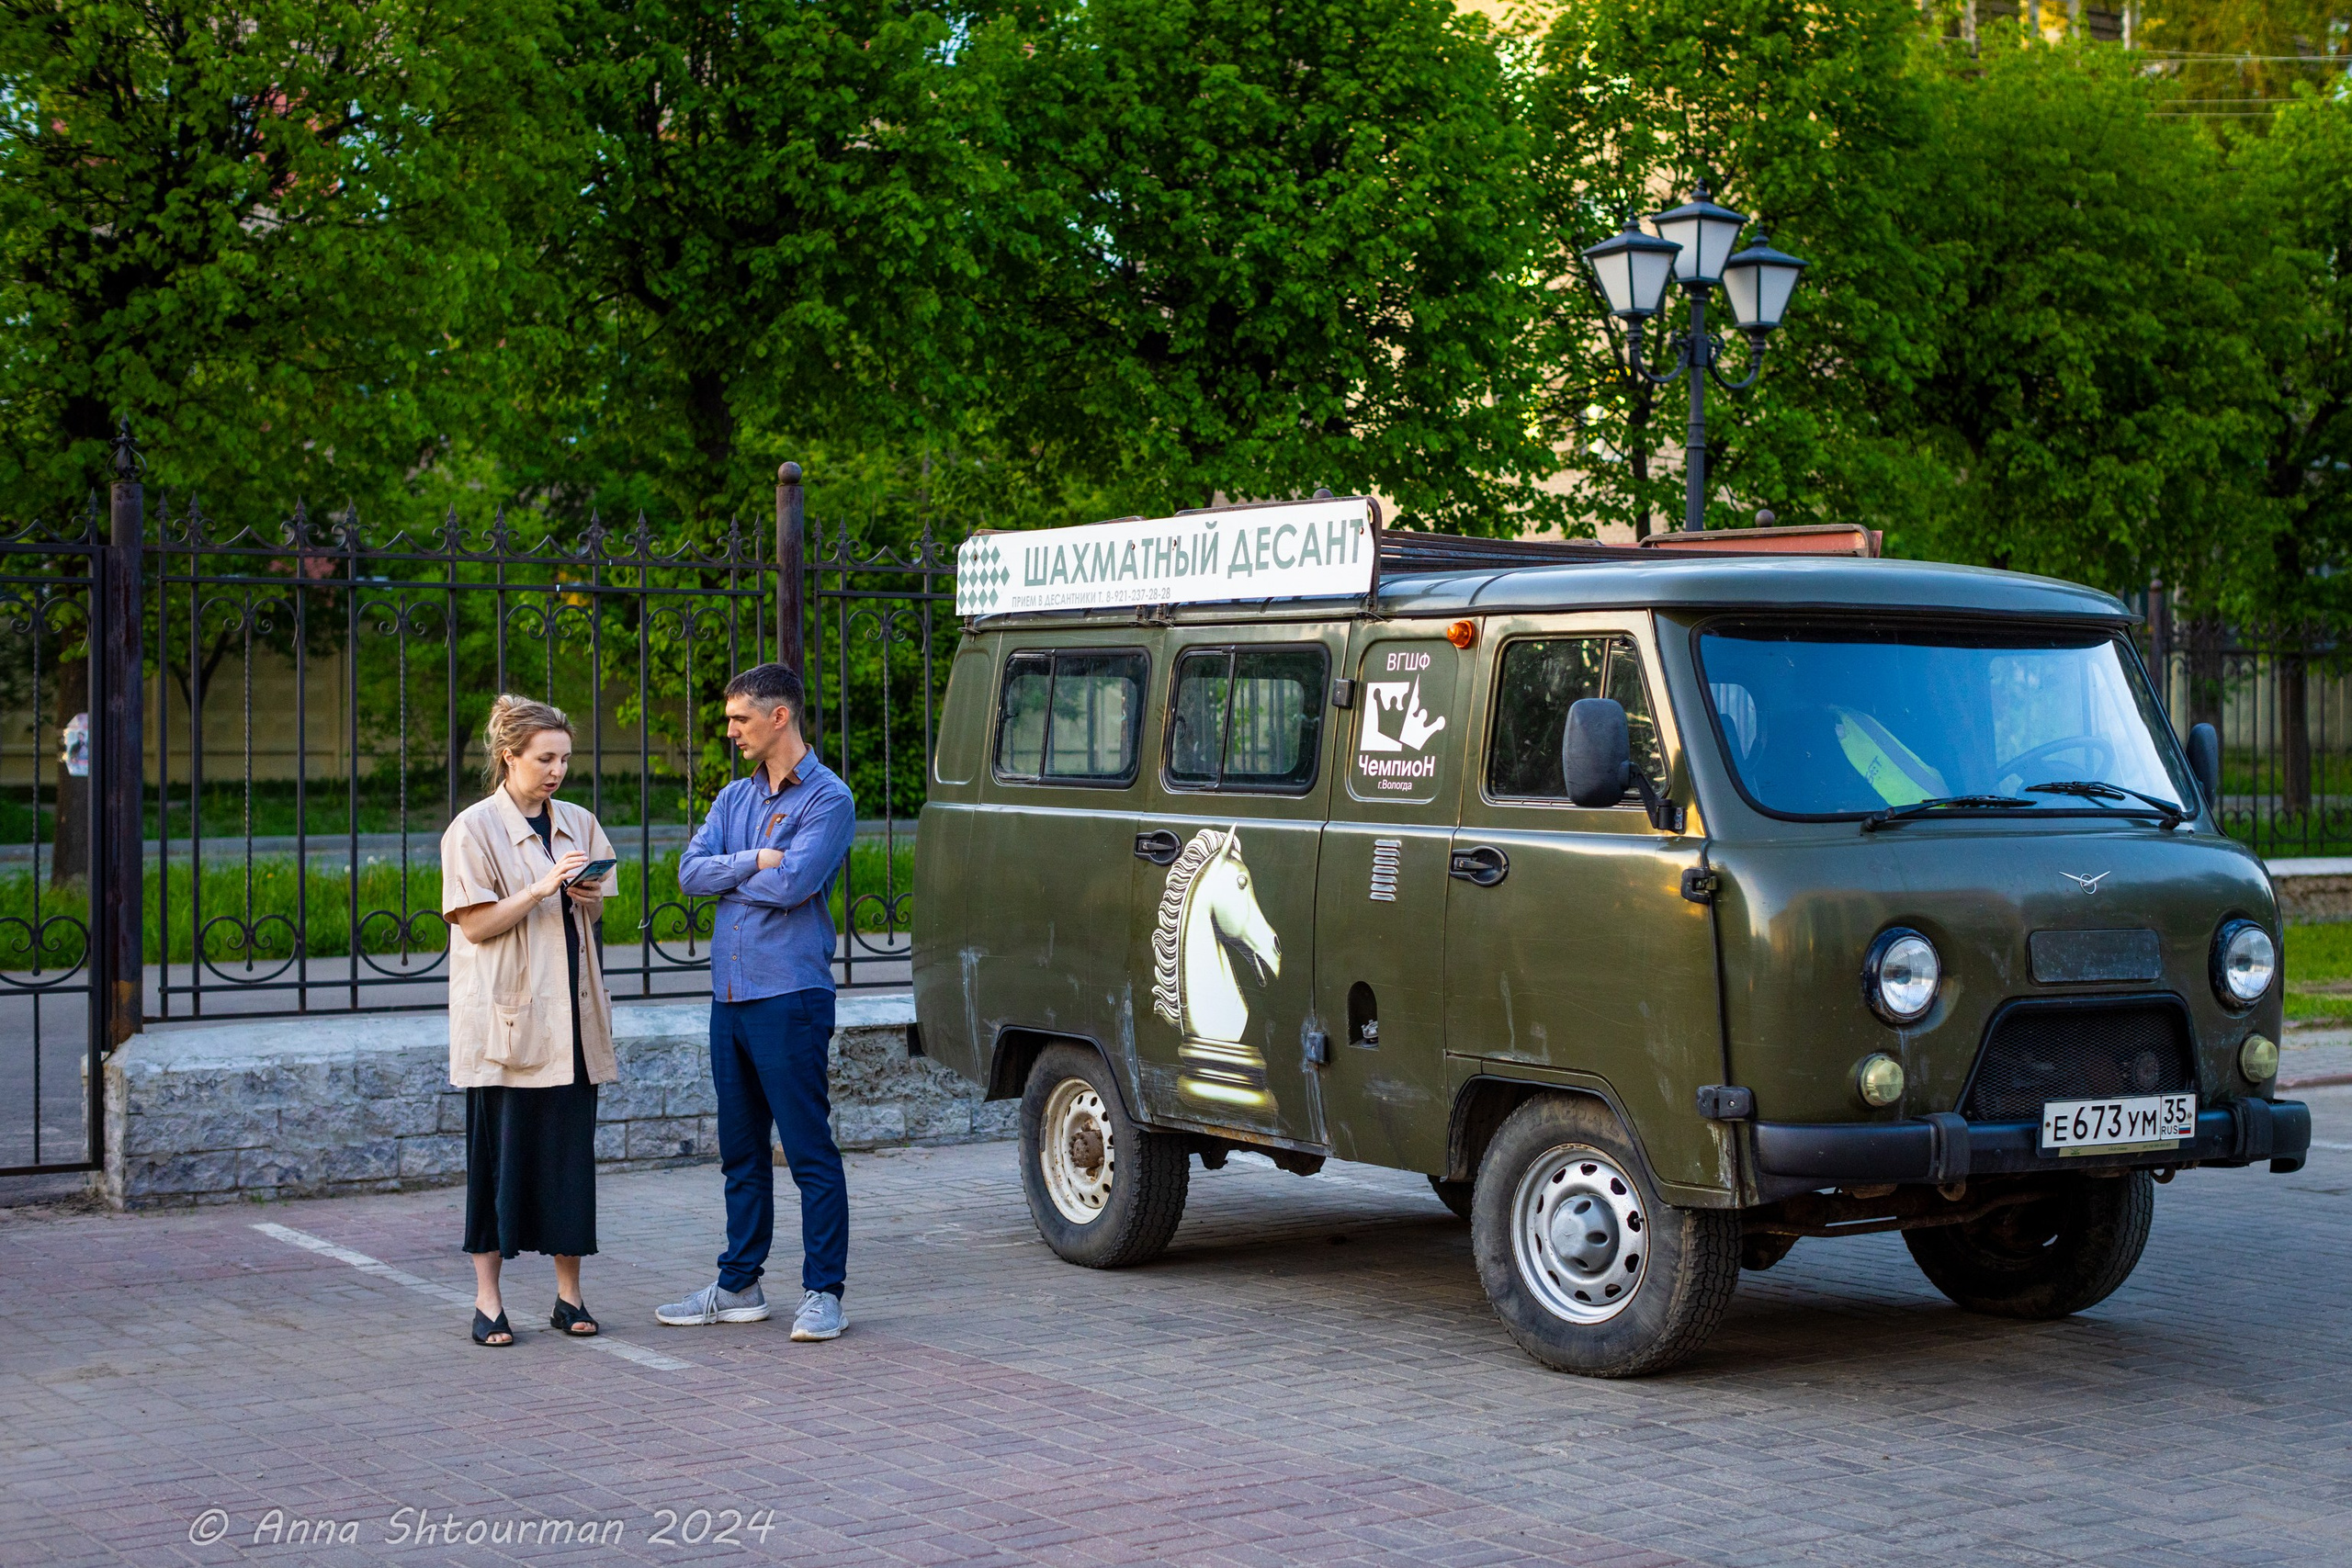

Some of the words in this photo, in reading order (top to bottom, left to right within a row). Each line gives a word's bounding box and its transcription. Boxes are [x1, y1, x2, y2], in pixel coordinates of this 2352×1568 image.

[1024, 521, 1218, 586] ШАХМАТНЫЙ
[1227, 518, 1364, 580] ДЕСАНТ
[1012, 596, 1036, 608] ПРИЕМ
[1045, 592, 1096, 607] ДЕСАНТНИКИ
[1106, 587, 1170, 604] 8-921-237-28-28
[1386, 652, 1430, 671] ВГШФ
[1377, 779, 1413, 792] г.Вологда
[2164, 1098, 2186, 1123] 35
[2161, 1124, 2178, 1135] RUS
